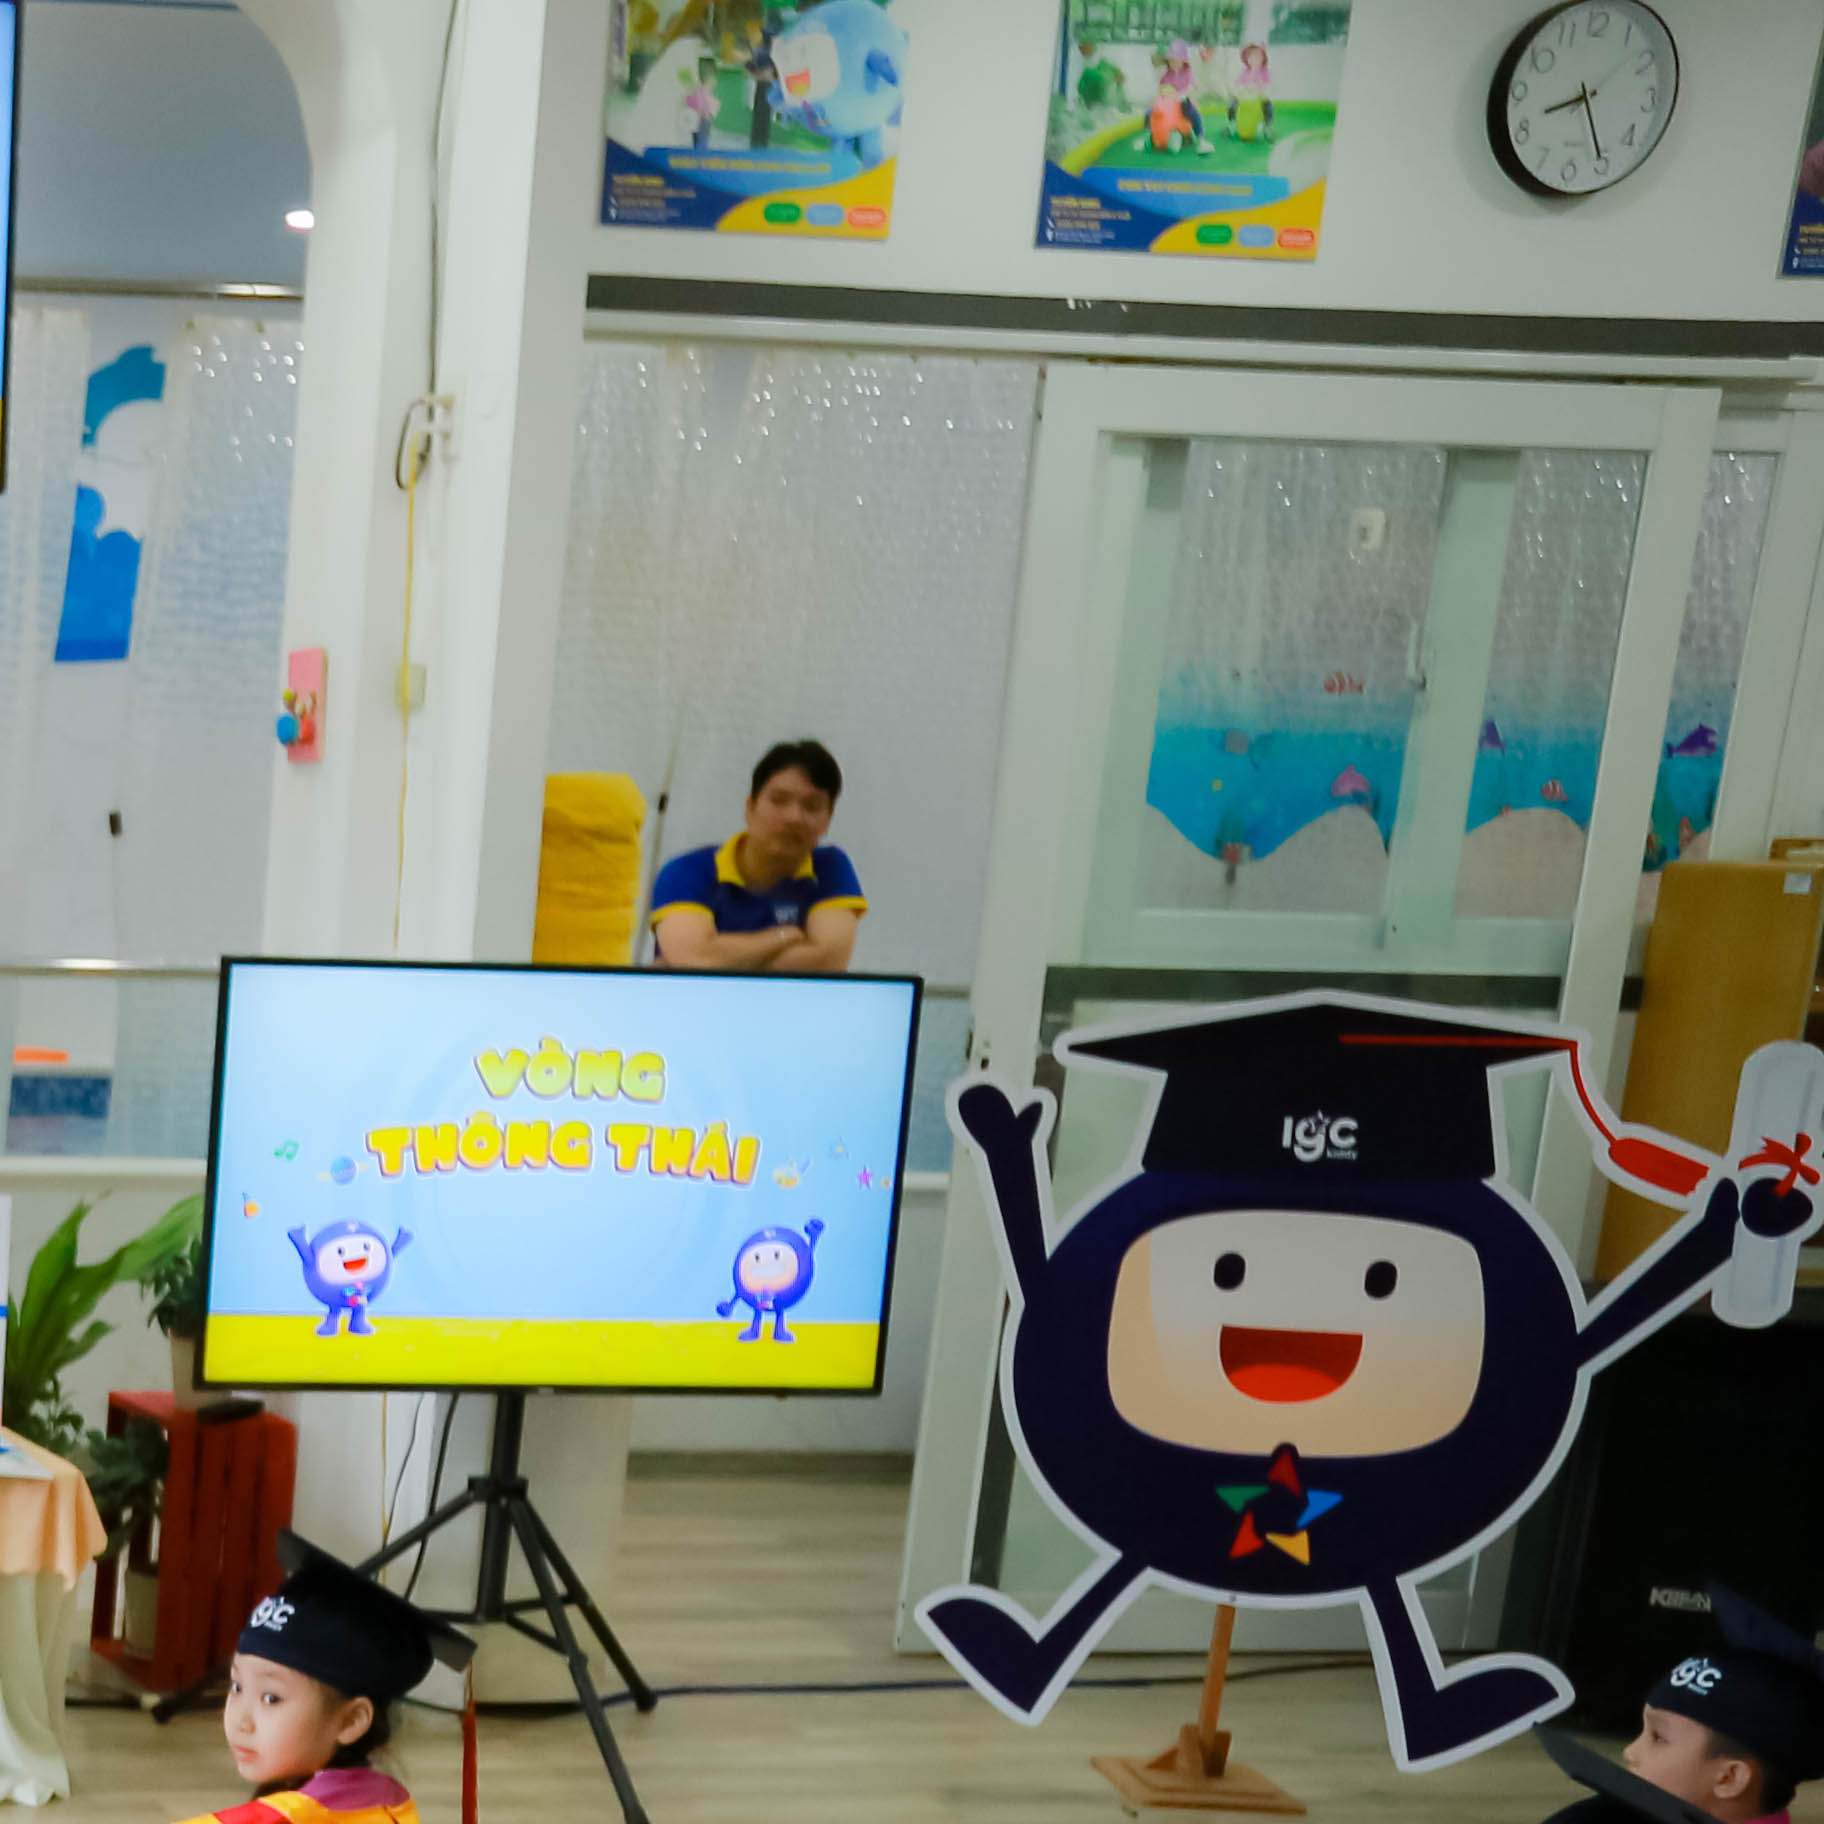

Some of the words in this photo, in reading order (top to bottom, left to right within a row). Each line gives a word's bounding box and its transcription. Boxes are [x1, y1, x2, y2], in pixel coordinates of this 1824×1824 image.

[1514, 119, 1530, 145] 8
[474, 1036, 667, 1103] VÒNG
[365, 1111, 593, 1178] THÔNG
[605, 1122, 761, 1186] THÁI
